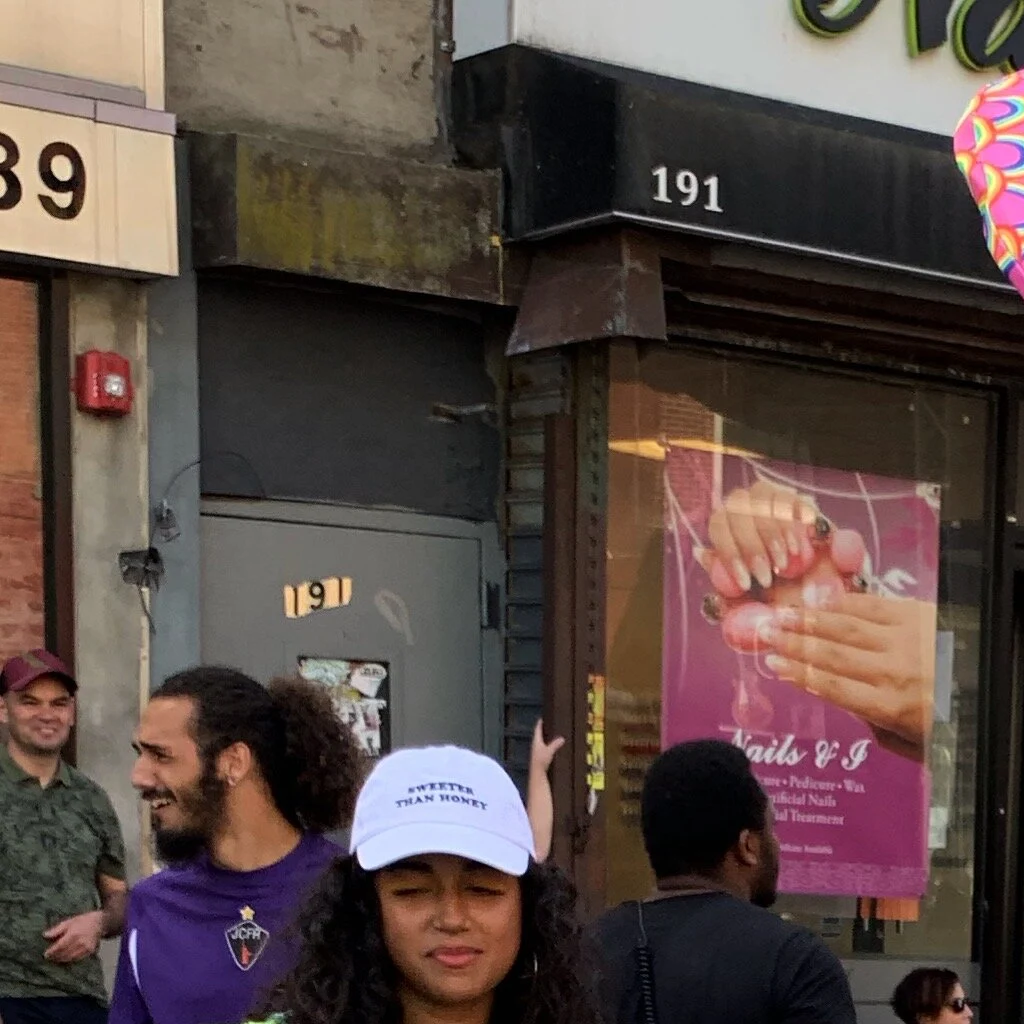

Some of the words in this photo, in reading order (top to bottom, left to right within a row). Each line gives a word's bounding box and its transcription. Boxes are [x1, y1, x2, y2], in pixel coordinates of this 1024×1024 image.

[651, 166, 723, 213] 191
[289, 577, 346, 616] 191
[731, 728, 808, 766] Nails
[815, 739, 841, 769] &
[395, 794, 434, 808] THAN
[439, 793, 488, 811] HONEY
[408, 782, 475, 795] SWEETER
[808, 793, 838, 807] Nails
